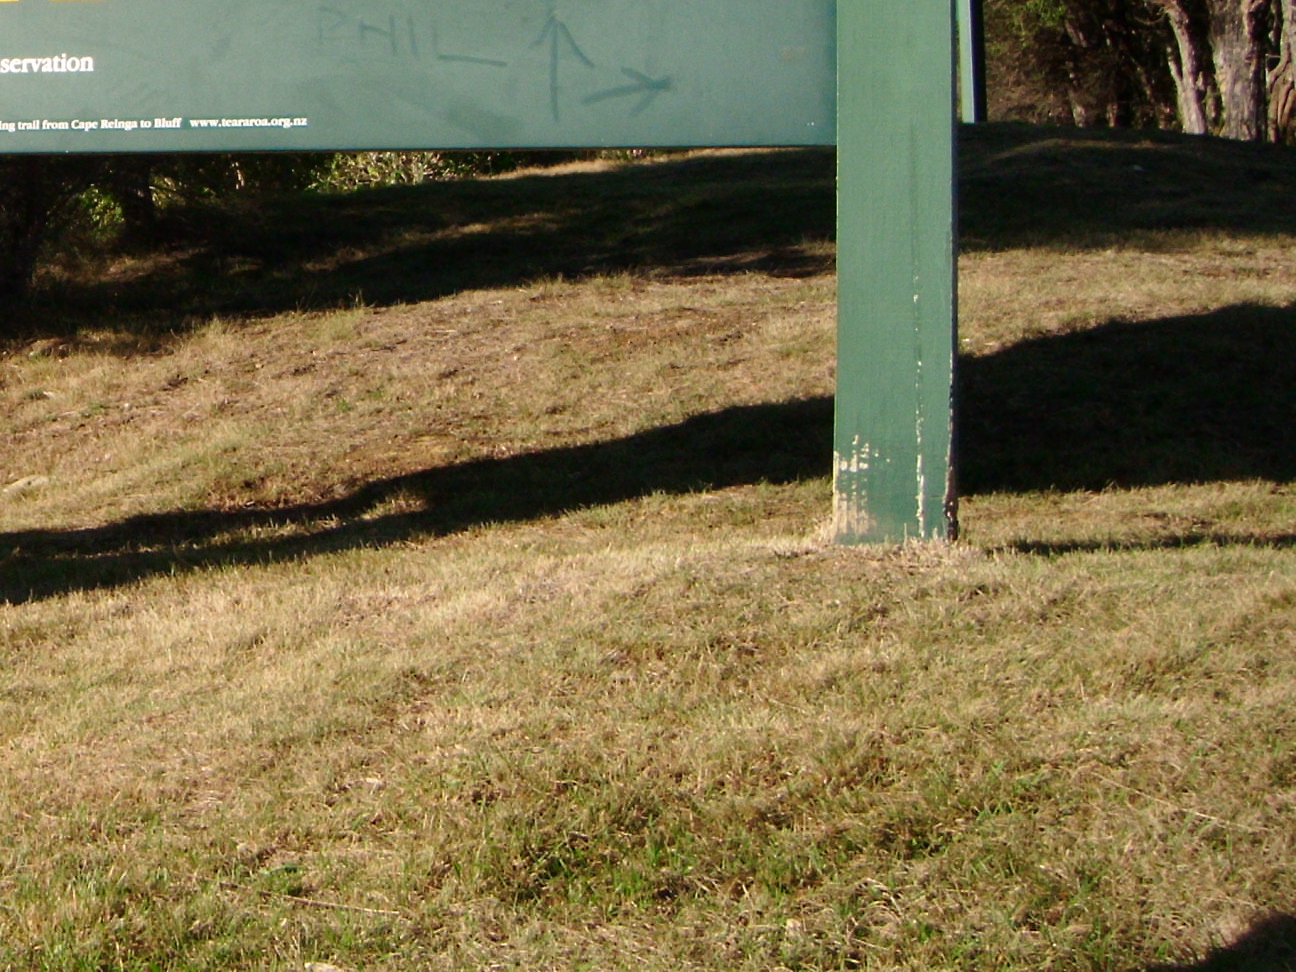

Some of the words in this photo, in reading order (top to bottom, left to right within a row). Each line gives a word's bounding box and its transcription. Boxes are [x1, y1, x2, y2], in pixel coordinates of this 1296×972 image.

[17, 119, 40, 130] trail
[42, 119, 69, 130] from
[71, 120, 98, 131] Cape
[101, 119, 138, 130] Reinga
[140, 119, 152, 128] to
[154, 117, 182, 128] Bluff
[190, 116, 307, 128] www.teararoa.org.nz
